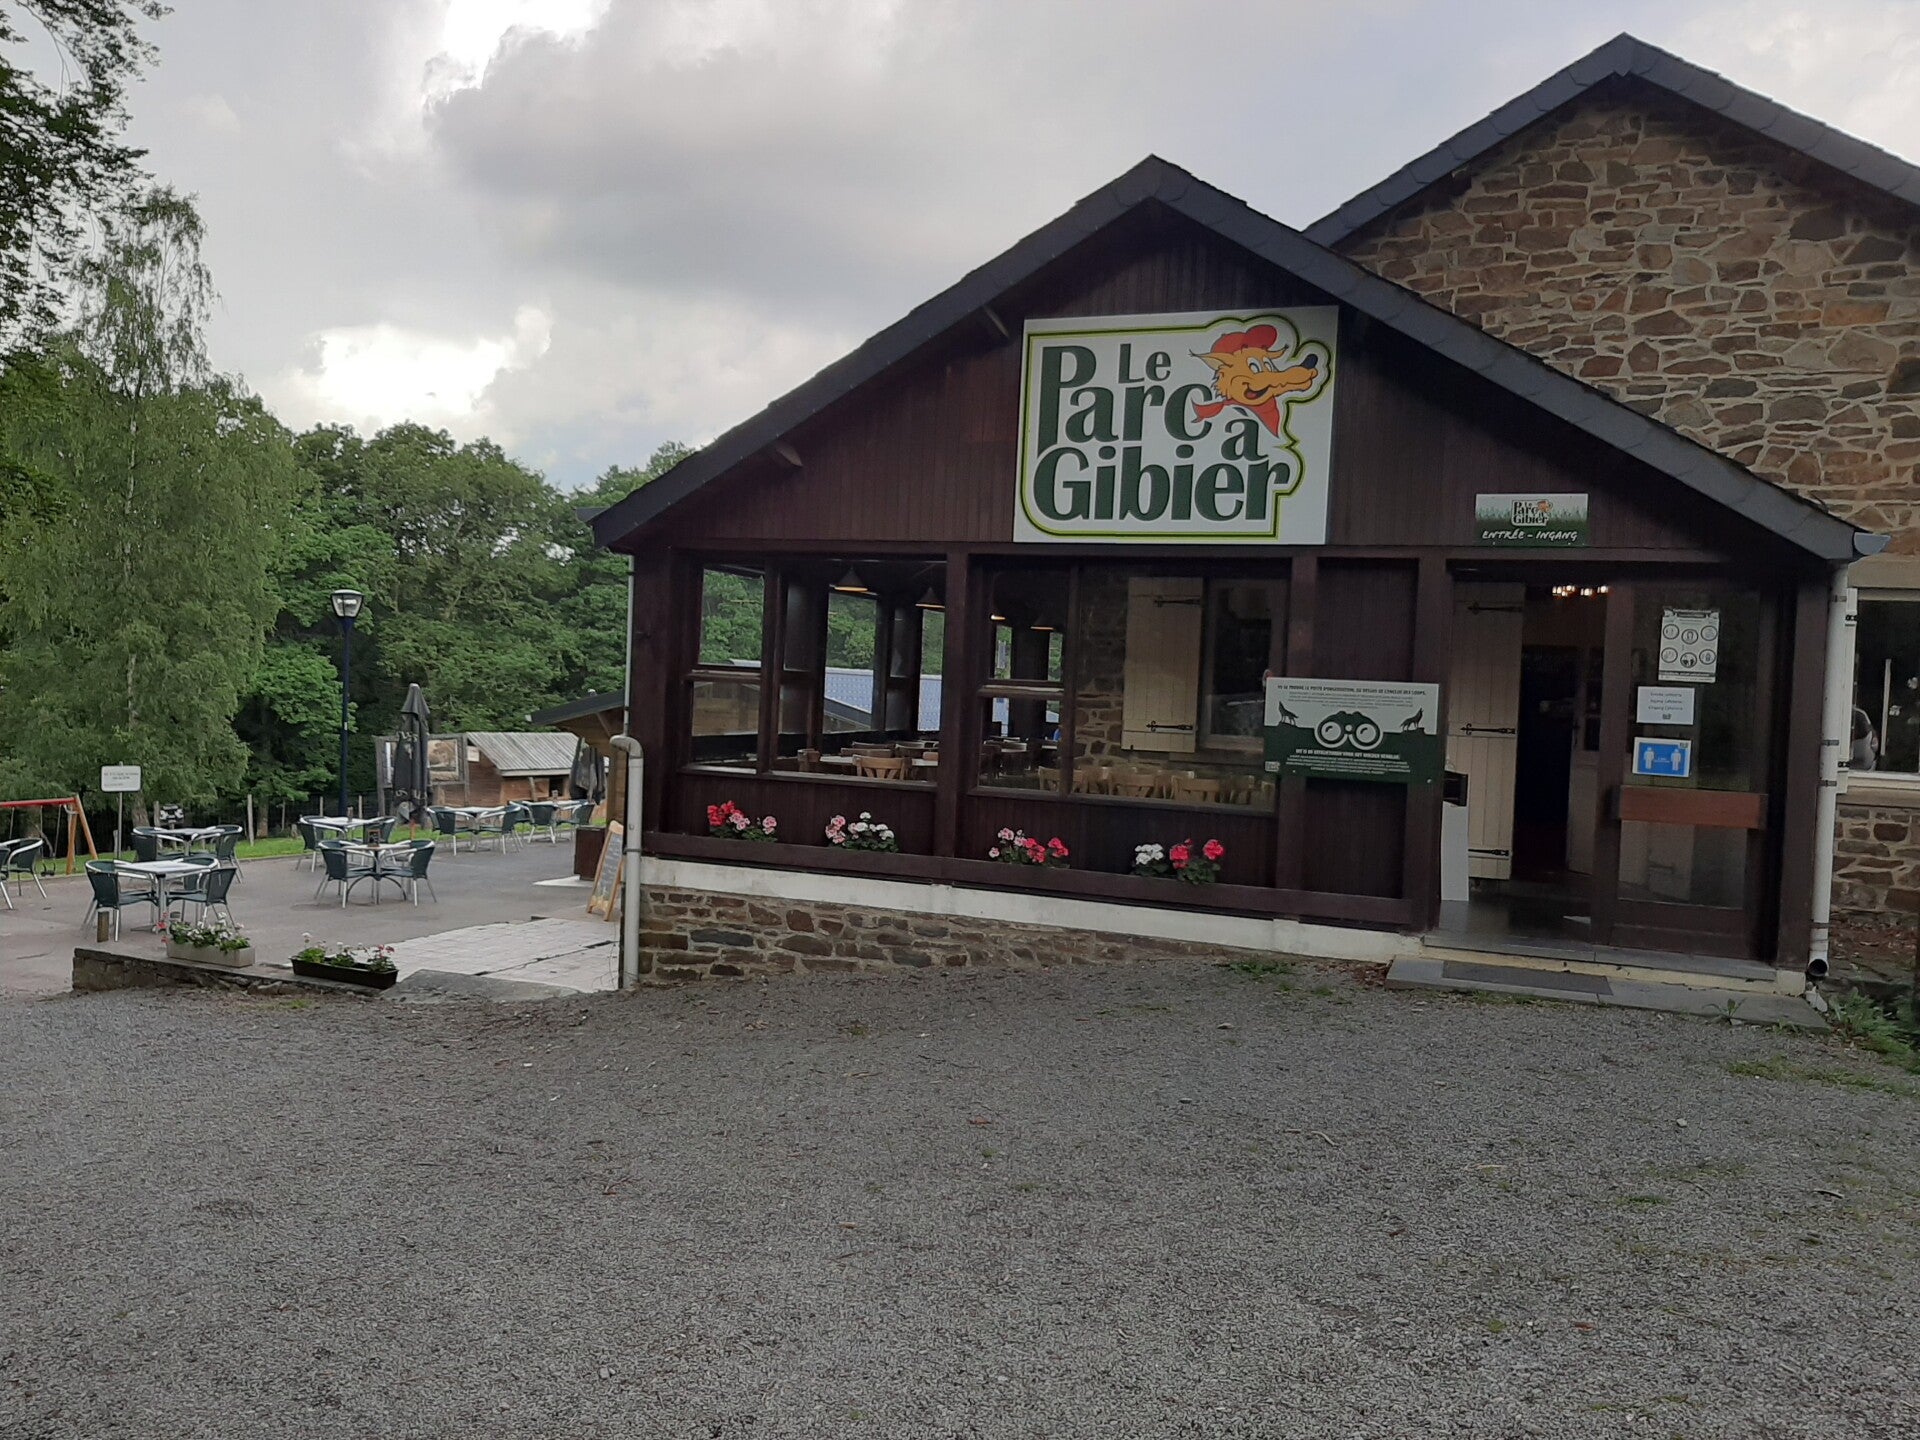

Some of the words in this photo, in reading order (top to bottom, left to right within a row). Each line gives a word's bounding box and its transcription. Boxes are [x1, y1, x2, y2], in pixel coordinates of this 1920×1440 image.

[1118, 343, 1171, 384] Le
[1037, 345, 1214, 459] Parc
[1220, 406, 1269, 461] à
[1033, 444, 1290, 521] Gibier
[1514, 513, 1548, 524] Gibier
[1536, 531, 1578, 541] INGANG
